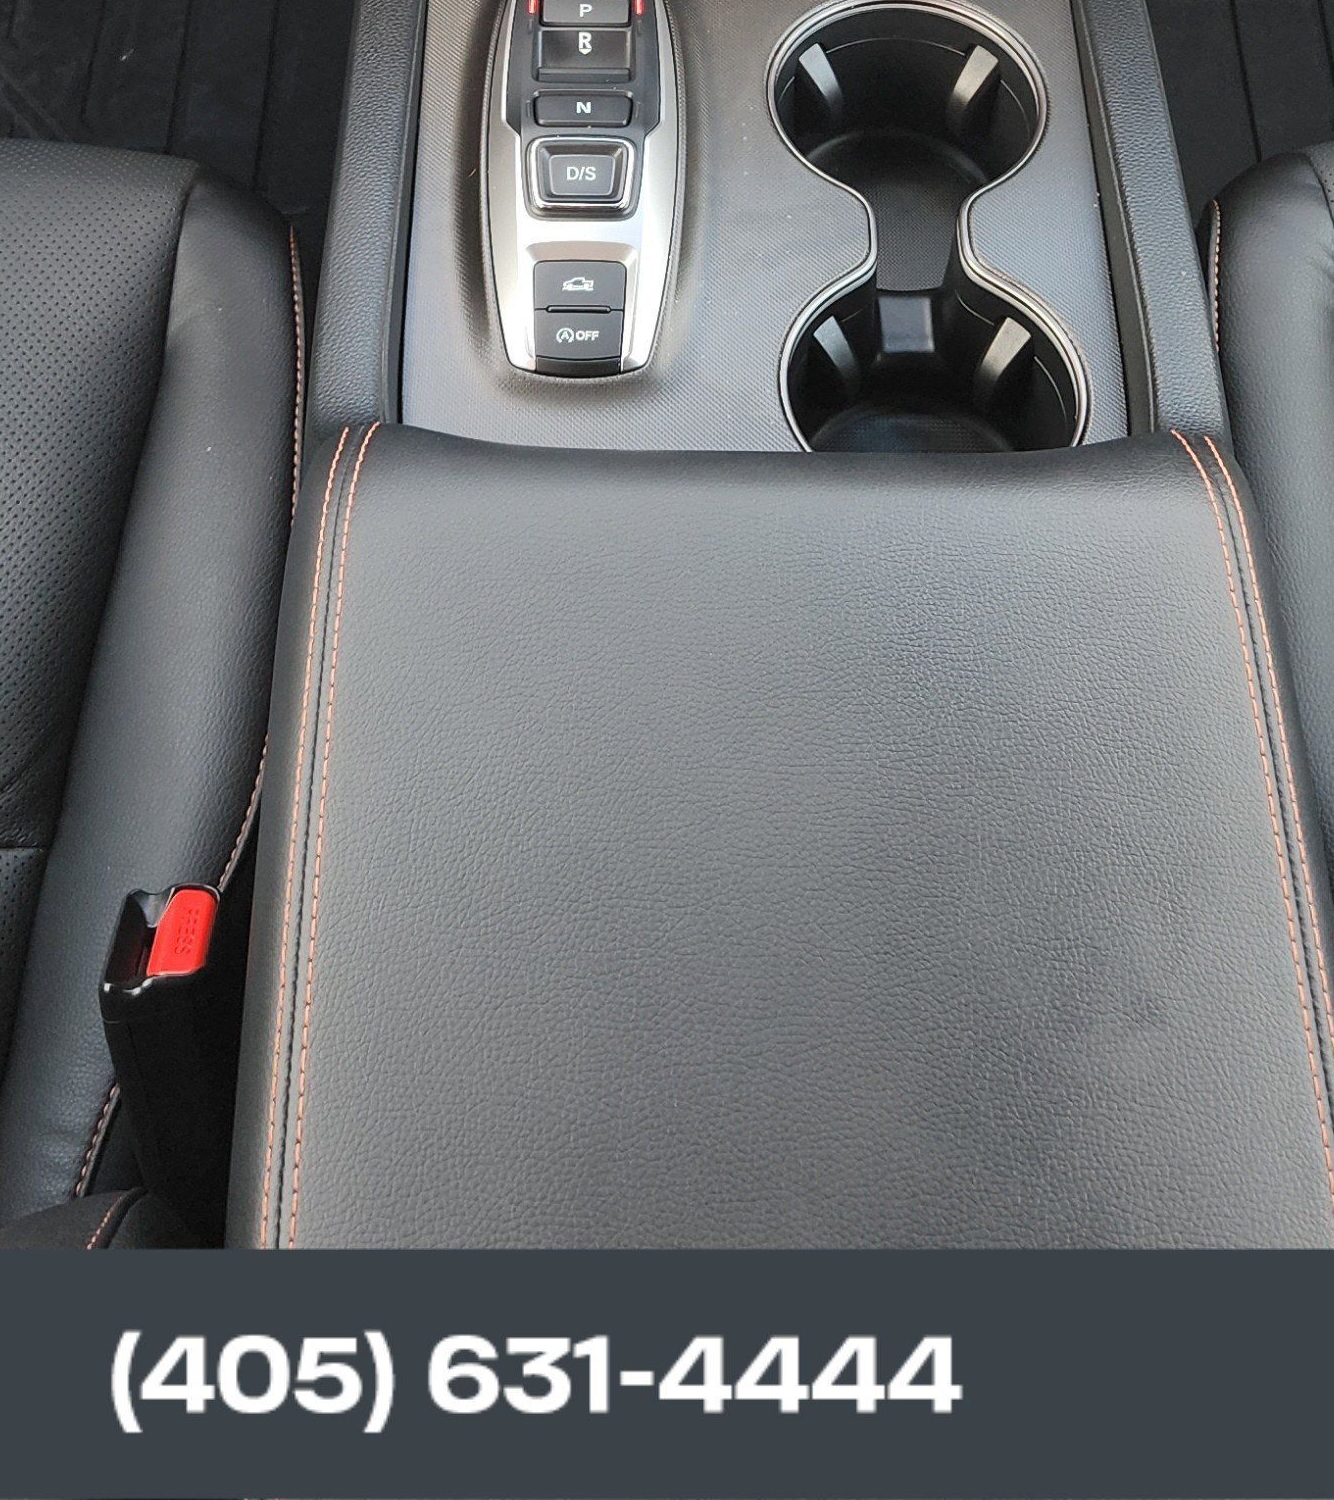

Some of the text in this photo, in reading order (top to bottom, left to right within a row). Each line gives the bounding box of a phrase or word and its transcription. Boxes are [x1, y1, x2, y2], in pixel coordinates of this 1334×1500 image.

[579, 3, 593, 18] P
[578, 31, 593, 49] R
[576, 101, 592, 114] N
[566, 166, 597, 181] D/S
[575, 330, 600, 341] OFF
